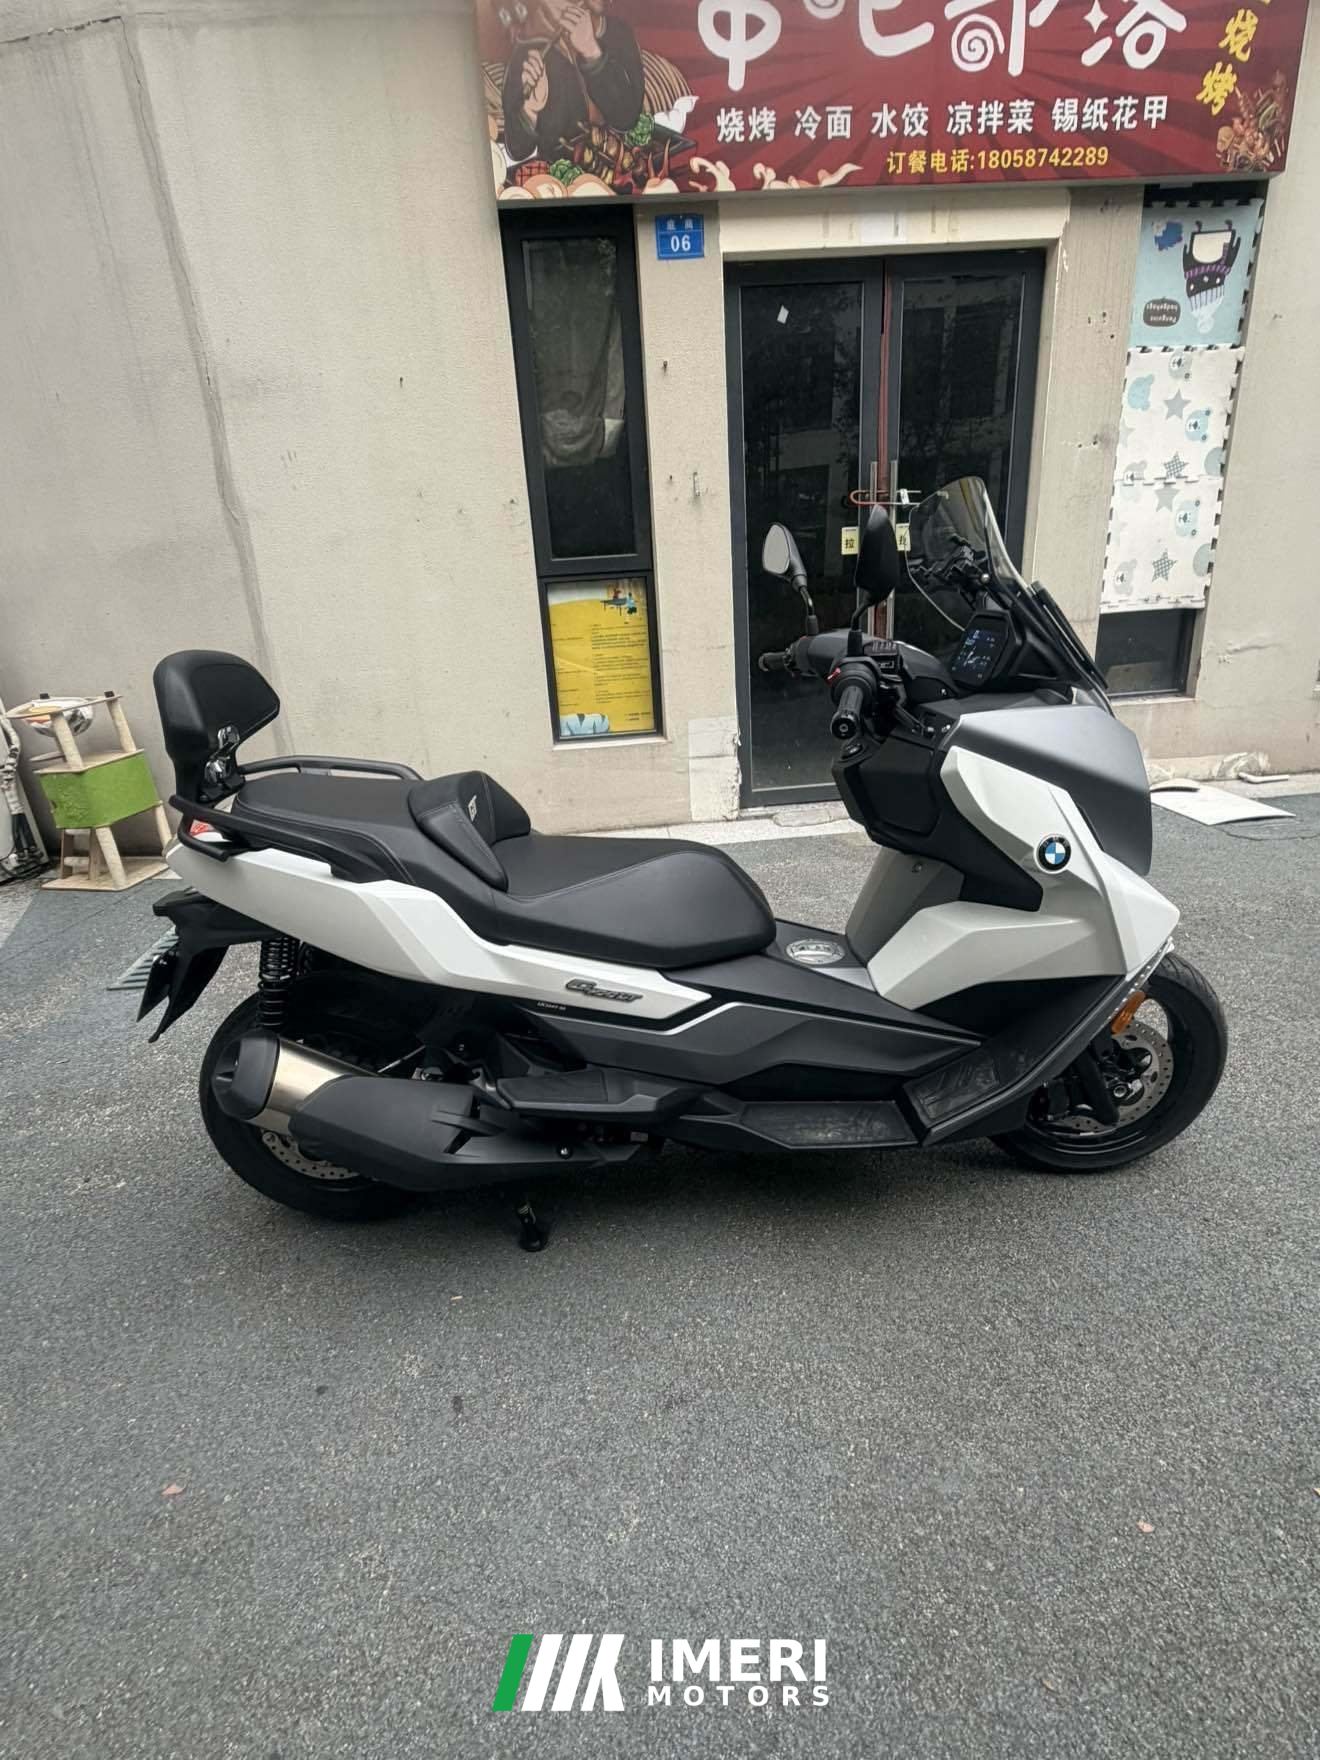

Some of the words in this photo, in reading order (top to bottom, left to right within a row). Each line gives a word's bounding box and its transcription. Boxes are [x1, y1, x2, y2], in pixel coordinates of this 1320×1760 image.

[716, 105, 777, 144] 烧烤
[794, 105, 853, 140] 冷面
[871, 102, 929, 138] 水饺
[946, 98, 1035, 136] 凉拌菜
[1051, 95, 1168, 133] 锡纸花甲
[886, 146, 1109, 175] 订餐电话:18058742289
[670, 234, 691, 252] 06
